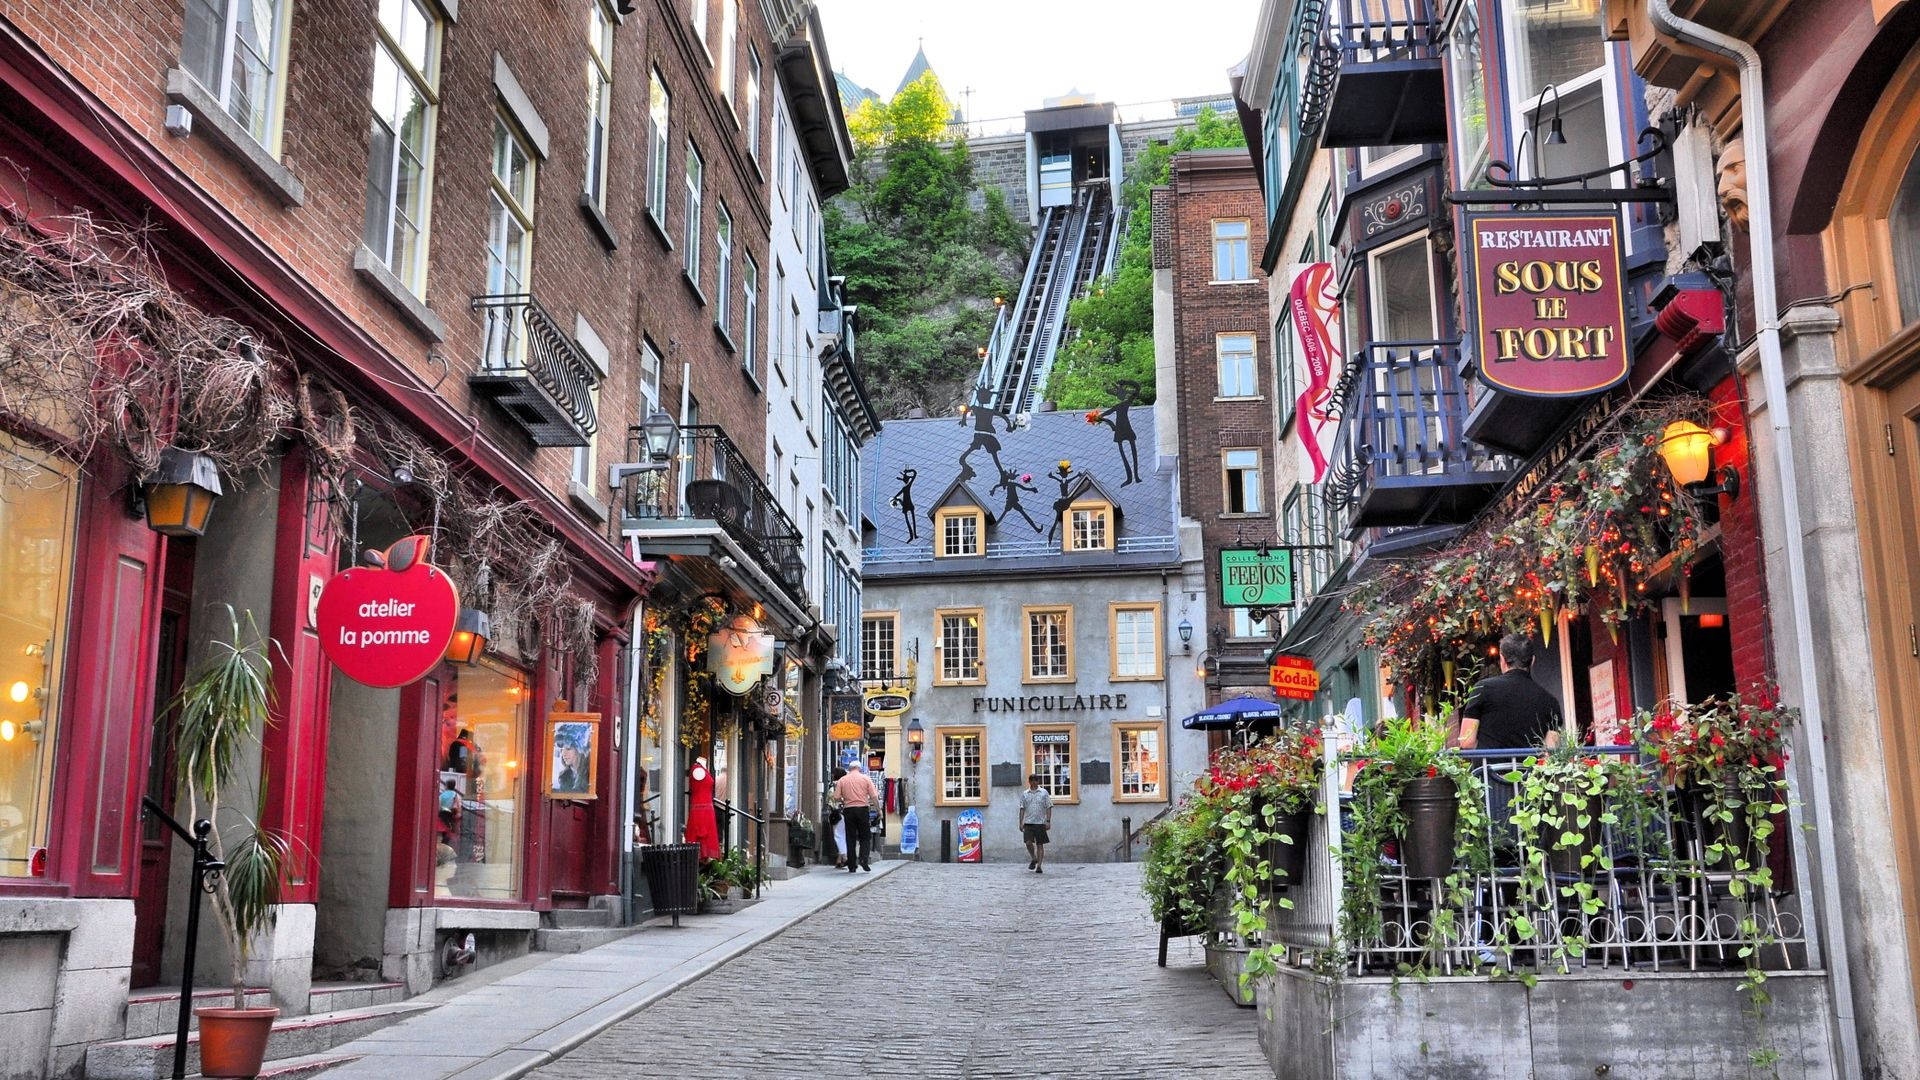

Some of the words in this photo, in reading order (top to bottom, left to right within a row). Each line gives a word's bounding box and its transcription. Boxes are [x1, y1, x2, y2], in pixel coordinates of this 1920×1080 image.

[1479, 228, 1612, 249] RESTAURANT
[1494, 259, 1603, 296] SOUS
[1533, 297, 1568, 320] LE
[1294, 298, 1311, 332] QUÉBEC
[1305, 333, 1317, 353] 1608
[1311, 356, 1324, 377] 2008
[1492, 325, 1614, 362] FORT
[359, 598, 416, 617] atelier
[339, 626, 356, 645] la
[360, 630, 430, 648] pomme
[1273, 669, 1318, 688] Kodak
[973, 694, 1128, 713] FUNICULAIRE
[1033, 734, 1069, 742] SOUVENIRS
